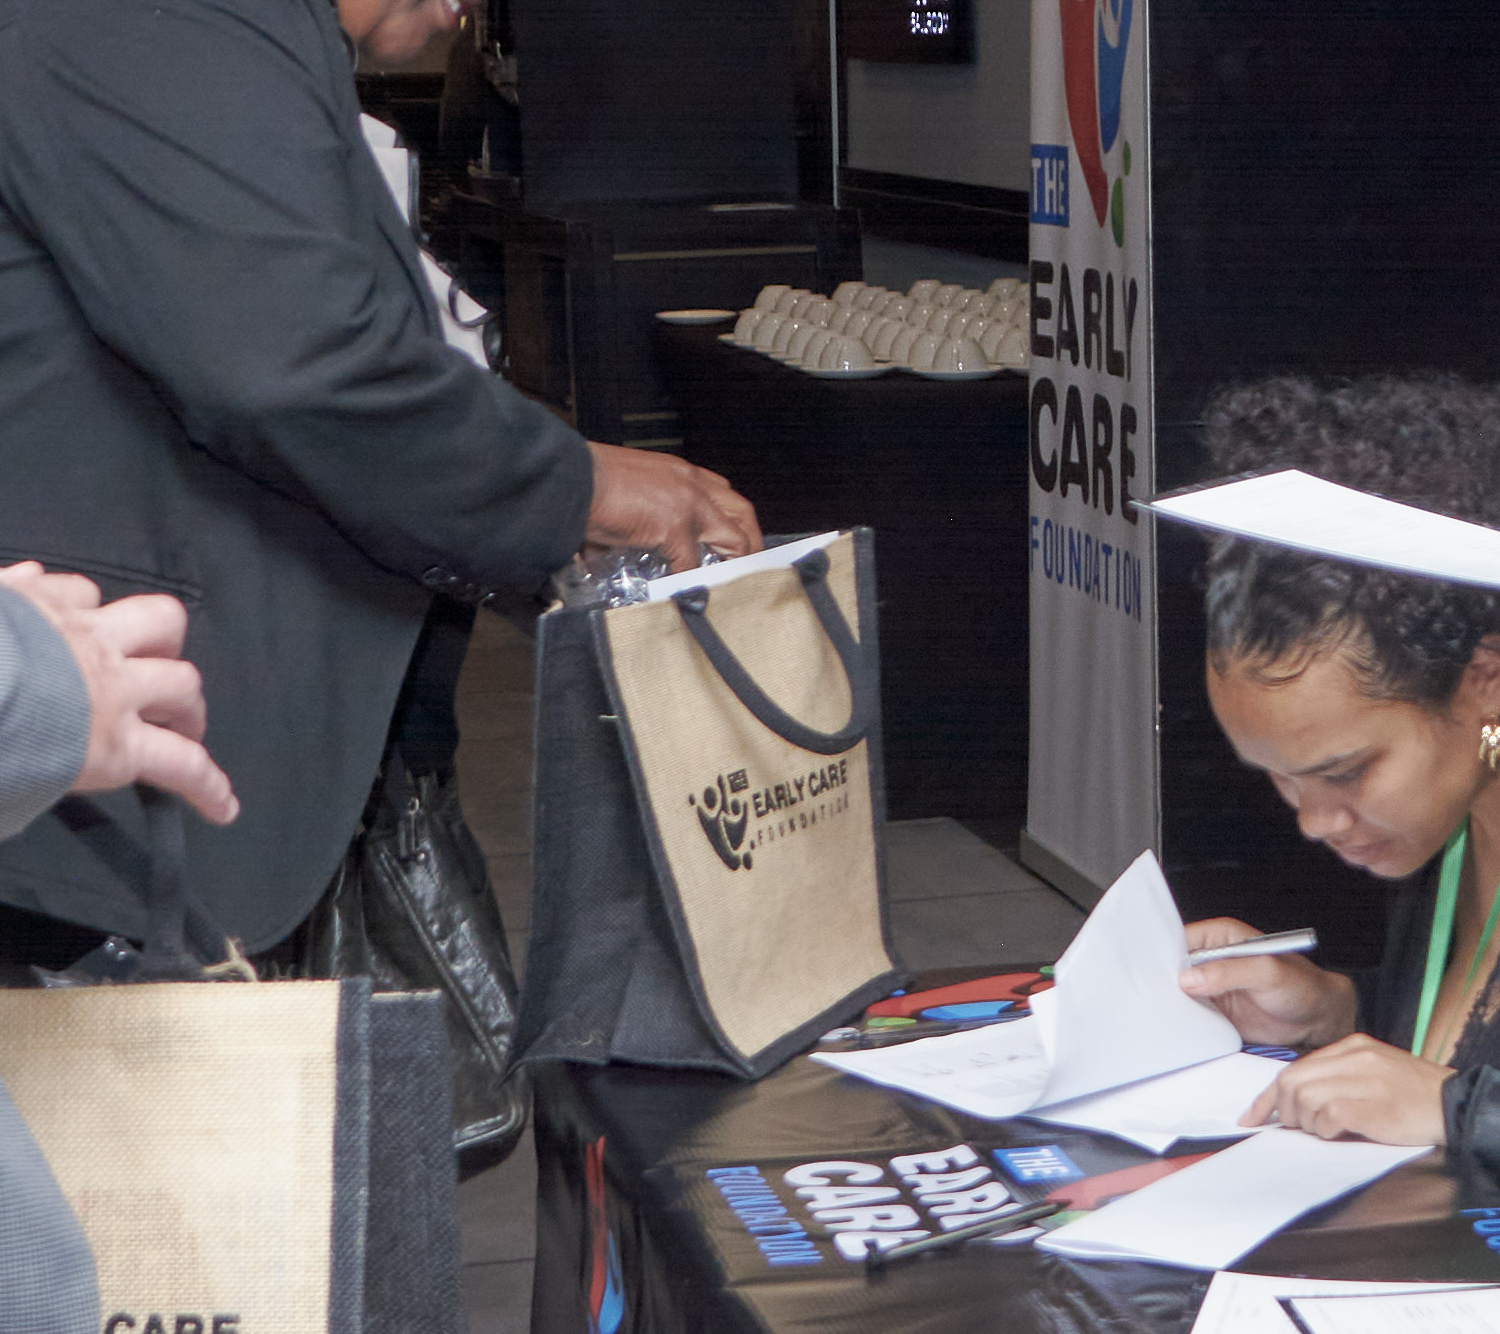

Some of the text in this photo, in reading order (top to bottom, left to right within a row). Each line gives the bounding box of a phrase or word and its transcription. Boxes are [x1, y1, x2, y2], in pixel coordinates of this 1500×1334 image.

[1031, 157, 1068, 224] THE
[1030, 260, 1139, 383] EARLY
[1030, 376, 1140, 526] CARE
[1030, 515, 1143, 624] FOUNDATION
[751, 774, 806, 818] EARLY
[807, 758, 849, 798] CARE
[1006, 1147, 1071, 1179] THE
